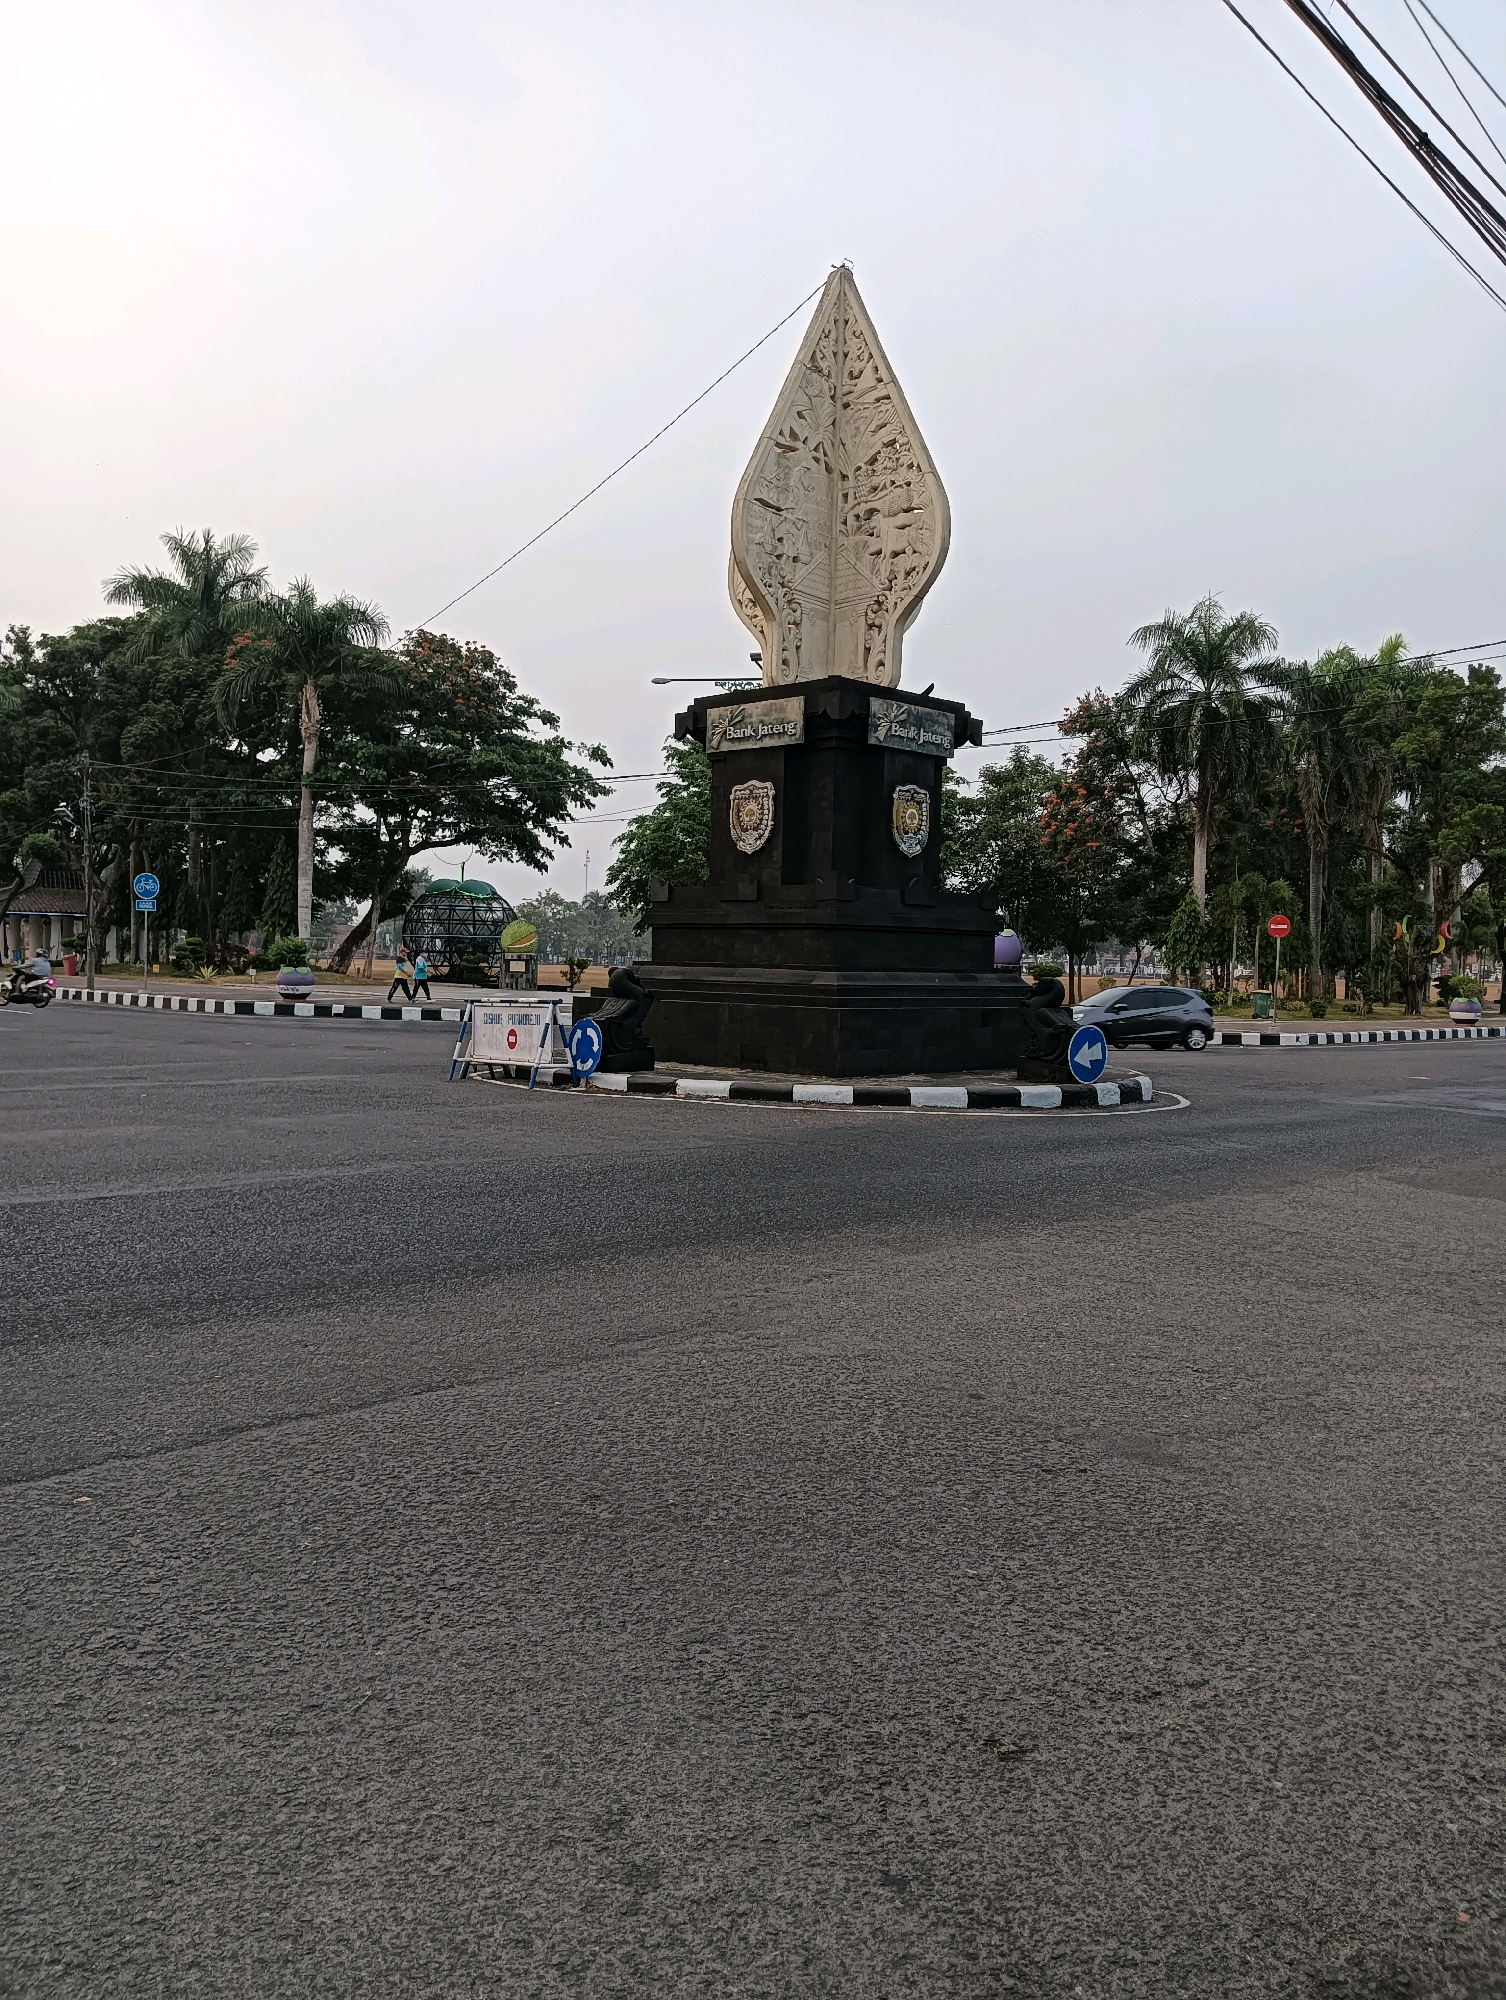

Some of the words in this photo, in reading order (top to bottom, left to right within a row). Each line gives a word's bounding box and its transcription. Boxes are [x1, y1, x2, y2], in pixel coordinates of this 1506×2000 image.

[726, 725, 756, 740] Bank
[757, 721, 798, 740] Jateng
[891, 722, 919, 740] Bank
[918, 728, 951, 749] Jateng
